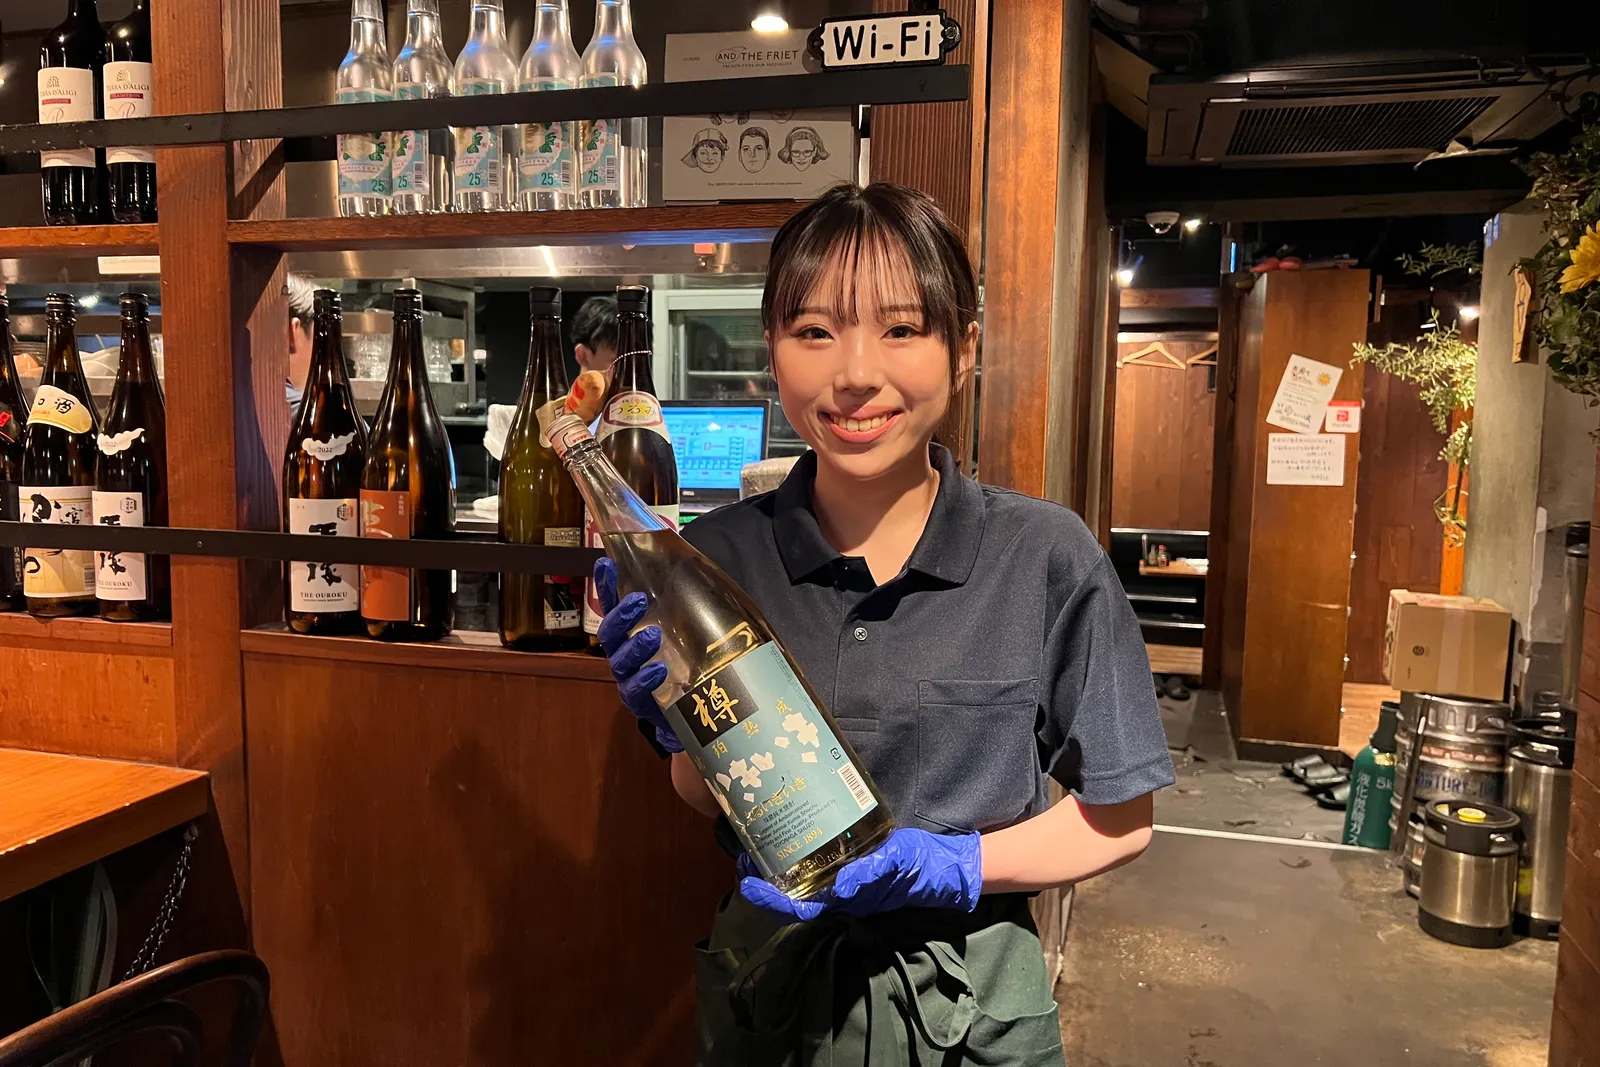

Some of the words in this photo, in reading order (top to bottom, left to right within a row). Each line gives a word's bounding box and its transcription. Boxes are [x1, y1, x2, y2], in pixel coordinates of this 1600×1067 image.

[833, 21, 931, 60] Wi-Fi
[718, 52, 737, 60] AND
[741, 51, 762, 60] THE
[766, 50, 799, 60] FRIET
[397, 175, 408, 188] 25
[469, 173, 481, 185] 25
[541, 173, 554, 186] 25
[588, 170, 600, 183] 25
[371, 180, 385, 192] 25
[692, 678, 739, 732] 樽
[777, 843, 803, 860] SINCE
[803, 827, 823, 843] 1894
